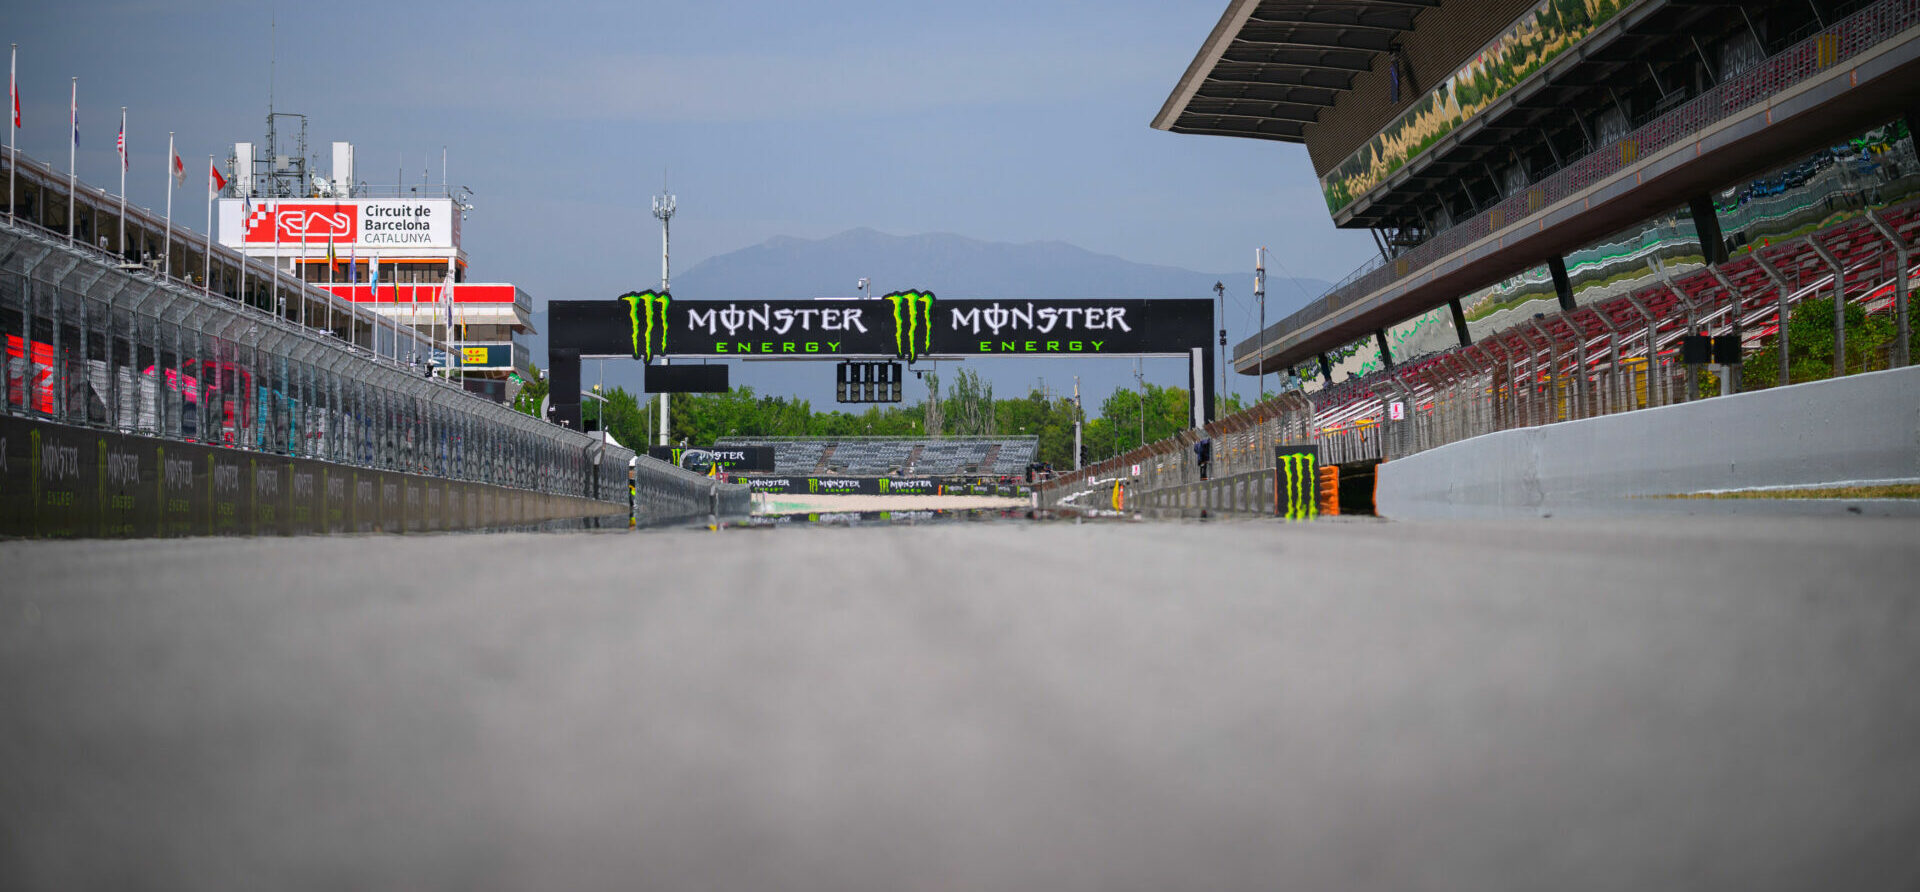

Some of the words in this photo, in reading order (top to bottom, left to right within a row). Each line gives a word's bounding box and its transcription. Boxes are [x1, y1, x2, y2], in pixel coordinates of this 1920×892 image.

[365, 204, 412, 217] Circuit
[414, 204, 431, 217] de
[364, 219, 430, 231] Barcelona
[364, 233, 432, 243] CATALUNYA
[687, 303, 868, 336] MONSTER
[951, 302, 1132, 335] MONSTER
[716, 342, 840, 352] ENERGY
[980, 341, 1104, 351] ENERGY
[42, 438, 79, 480] MONSTER
